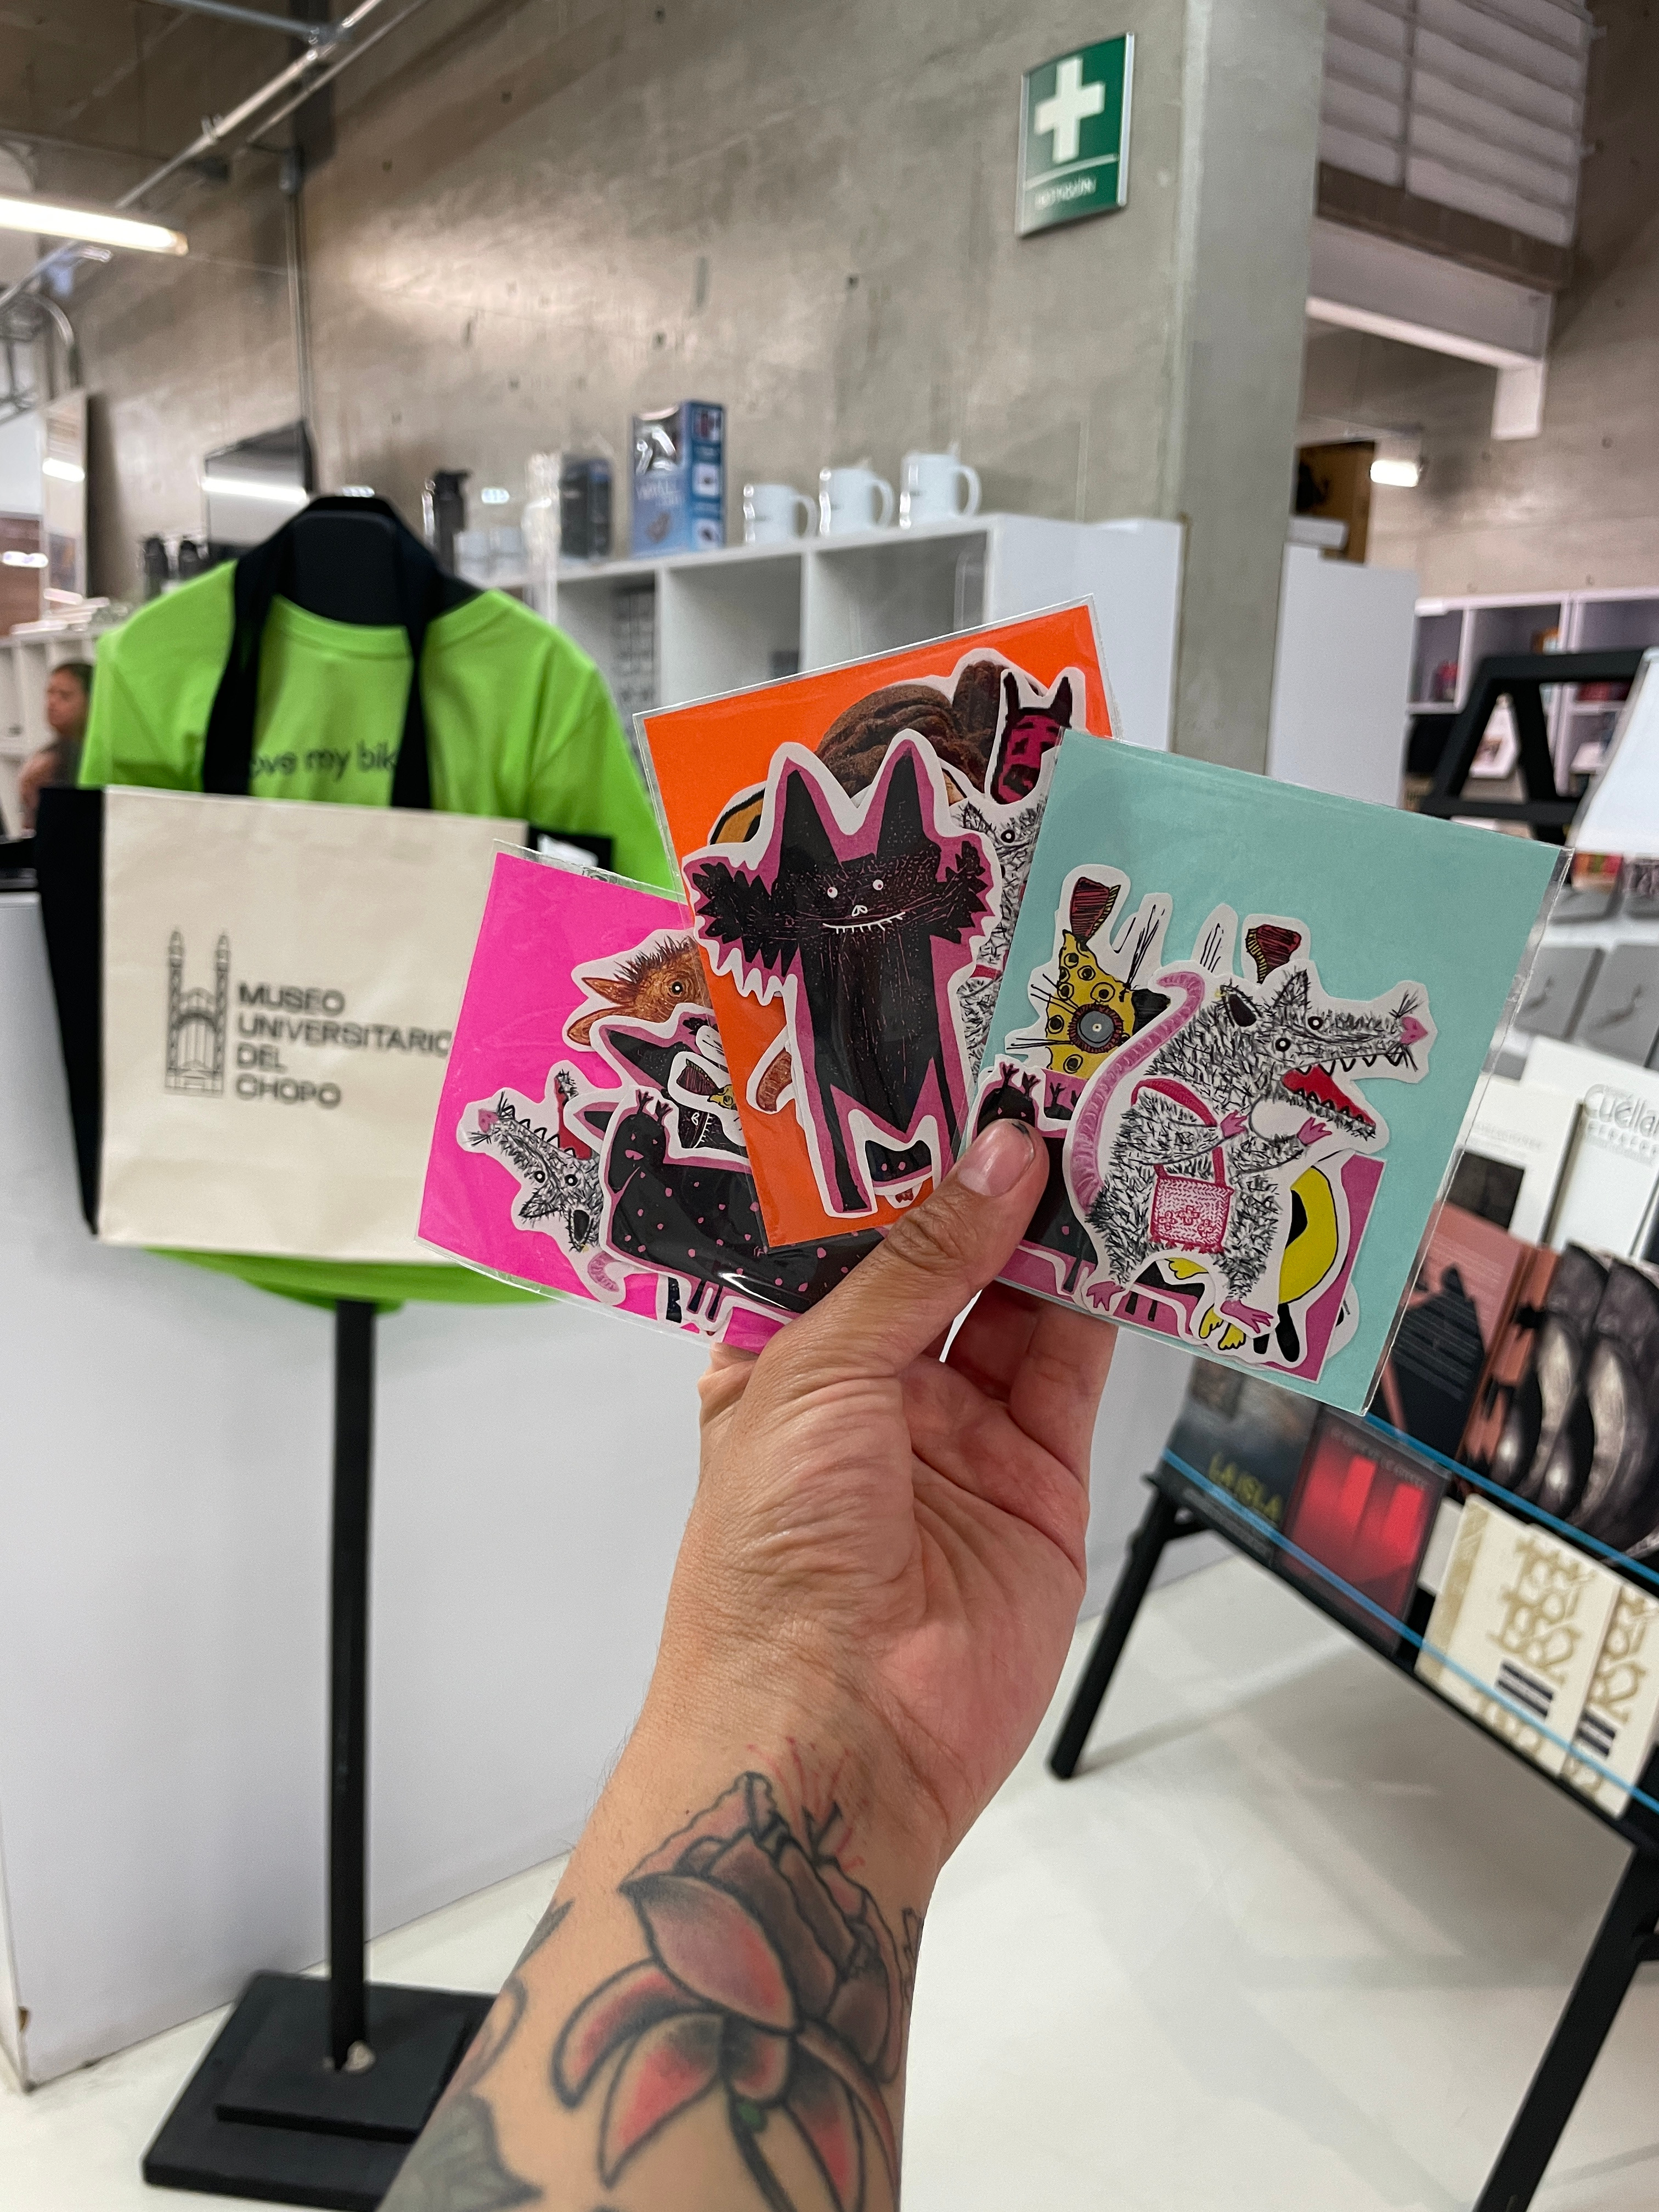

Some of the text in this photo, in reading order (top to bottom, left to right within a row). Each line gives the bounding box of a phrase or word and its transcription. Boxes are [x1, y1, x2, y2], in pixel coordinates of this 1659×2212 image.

[304, 748, 351, 782] my
[238, 982, 346, 1016] MUSEO
[238, 1013, 453, 1057] UNIVERSITARIO
[236, 1042, 286, 1073] DEL
[235, 1073, 342, 1110] CHOPO
